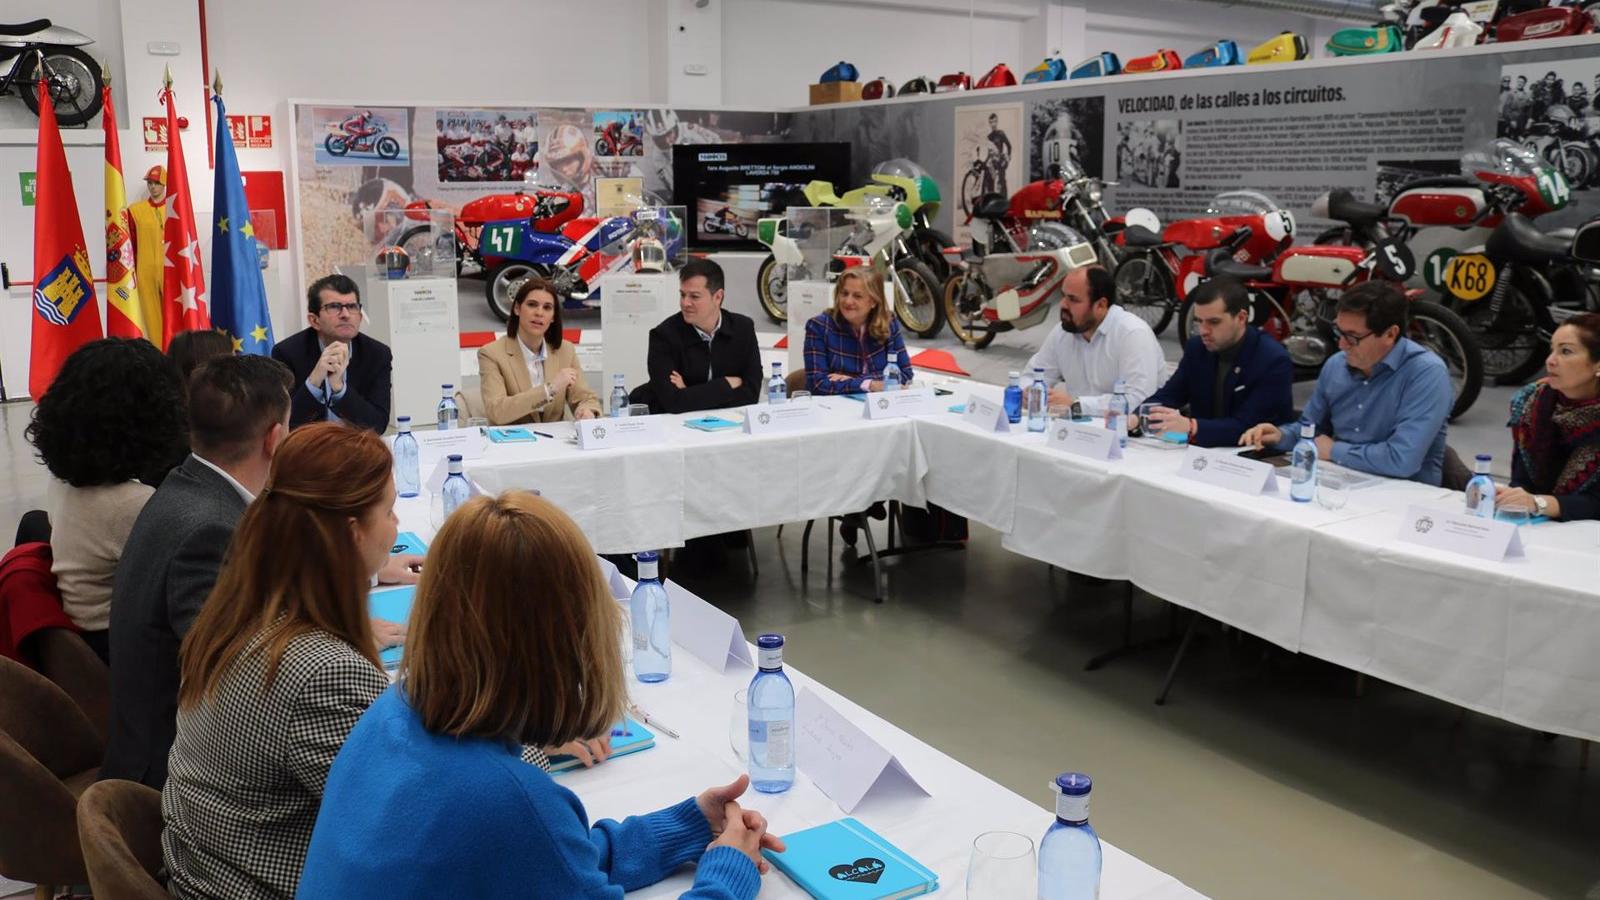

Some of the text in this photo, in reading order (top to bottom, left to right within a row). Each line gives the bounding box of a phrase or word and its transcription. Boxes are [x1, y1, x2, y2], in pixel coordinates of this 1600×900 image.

[1118, 85, 1346, 113] VELOCIDAD, de las calles a los circuitos.
[1541, 171, 1569, 205] 14
[1280, 209, 1292, 234] 5
[491, 226, 514, 252] 47
[1384, 244, 1407, 275] 5
[1451, 259, 1487, 293] K68
[836, 860, 884, 880] ALCALÁ
